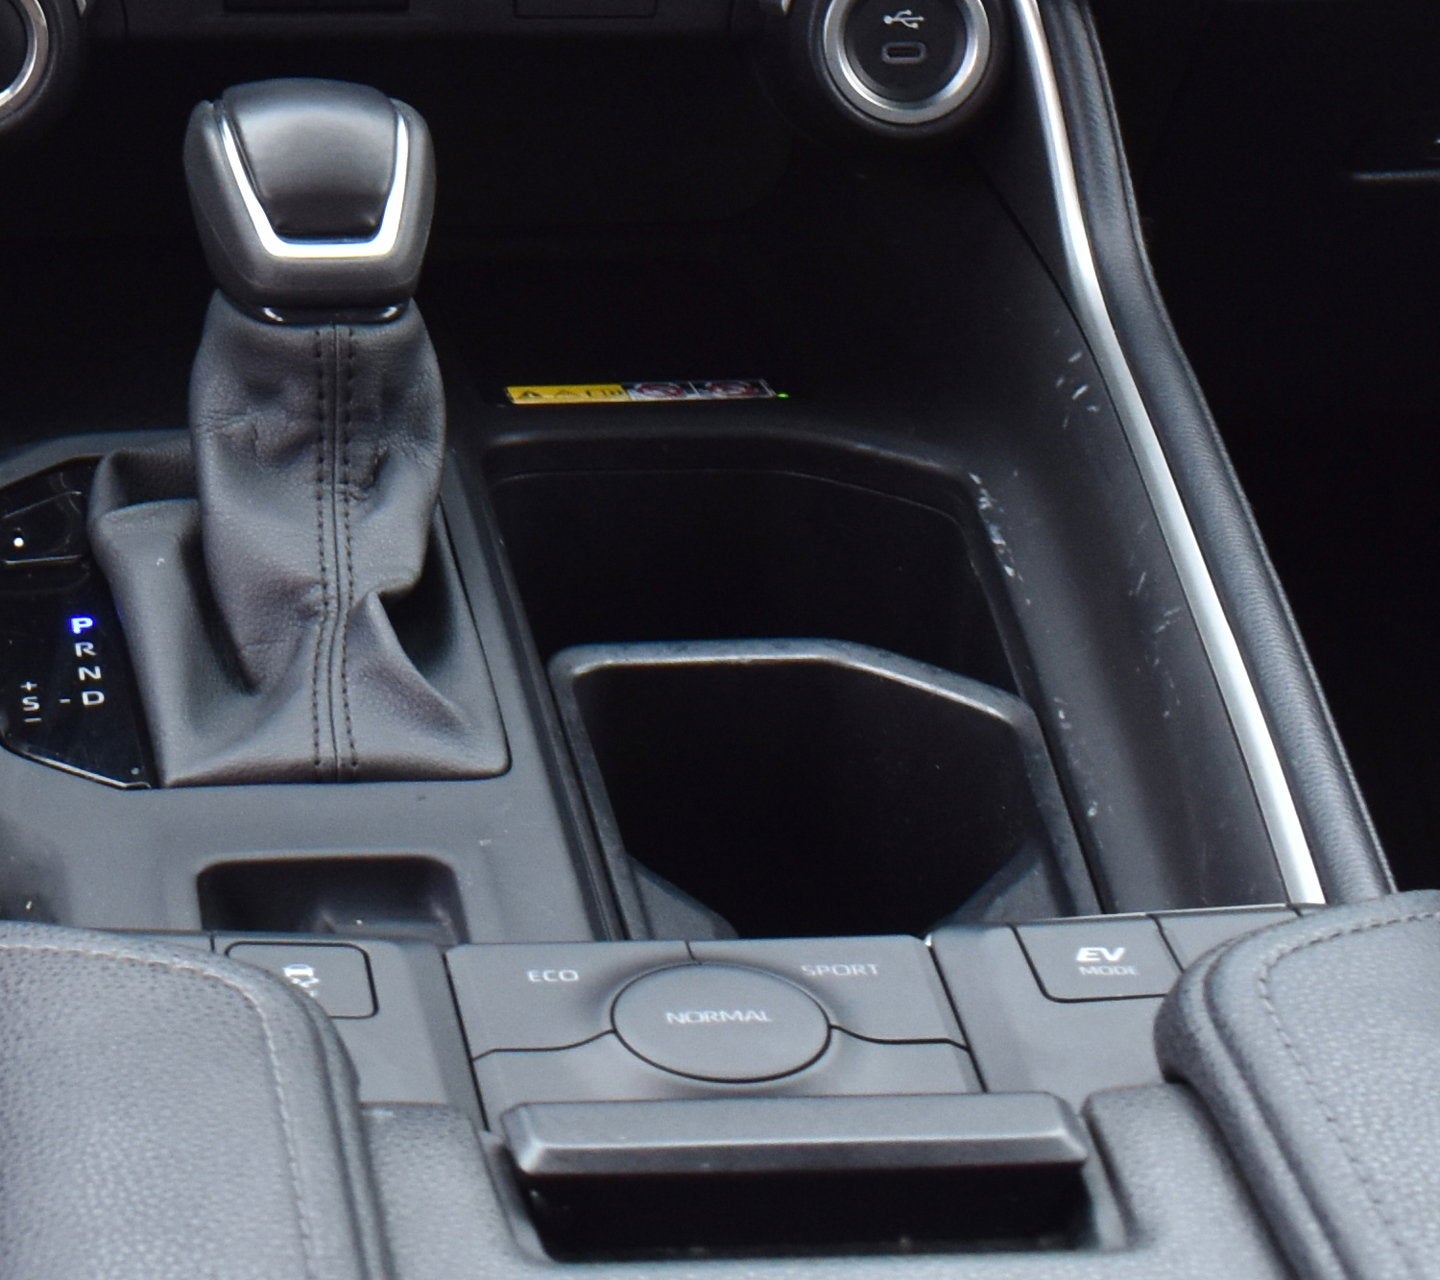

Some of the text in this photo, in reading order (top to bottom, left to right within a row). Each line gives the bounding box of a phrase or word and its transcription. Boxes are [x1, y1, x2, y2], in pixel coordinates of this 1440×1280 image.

[70, 617, 93, 634] P
[75, 641, 97, 657] R
[78, 665, 102, 681] N
[22, 696, 41, 712] S
[82, 691, 105, 706] D
[1076, 947, 1126, 962] EV
[527, 969, 580, 984] ECO
[800, 963, 880, 977] SPORT
[1078, 965, 1138, 977] MODE
[666, 1010, 773, 1024] NORMAL
